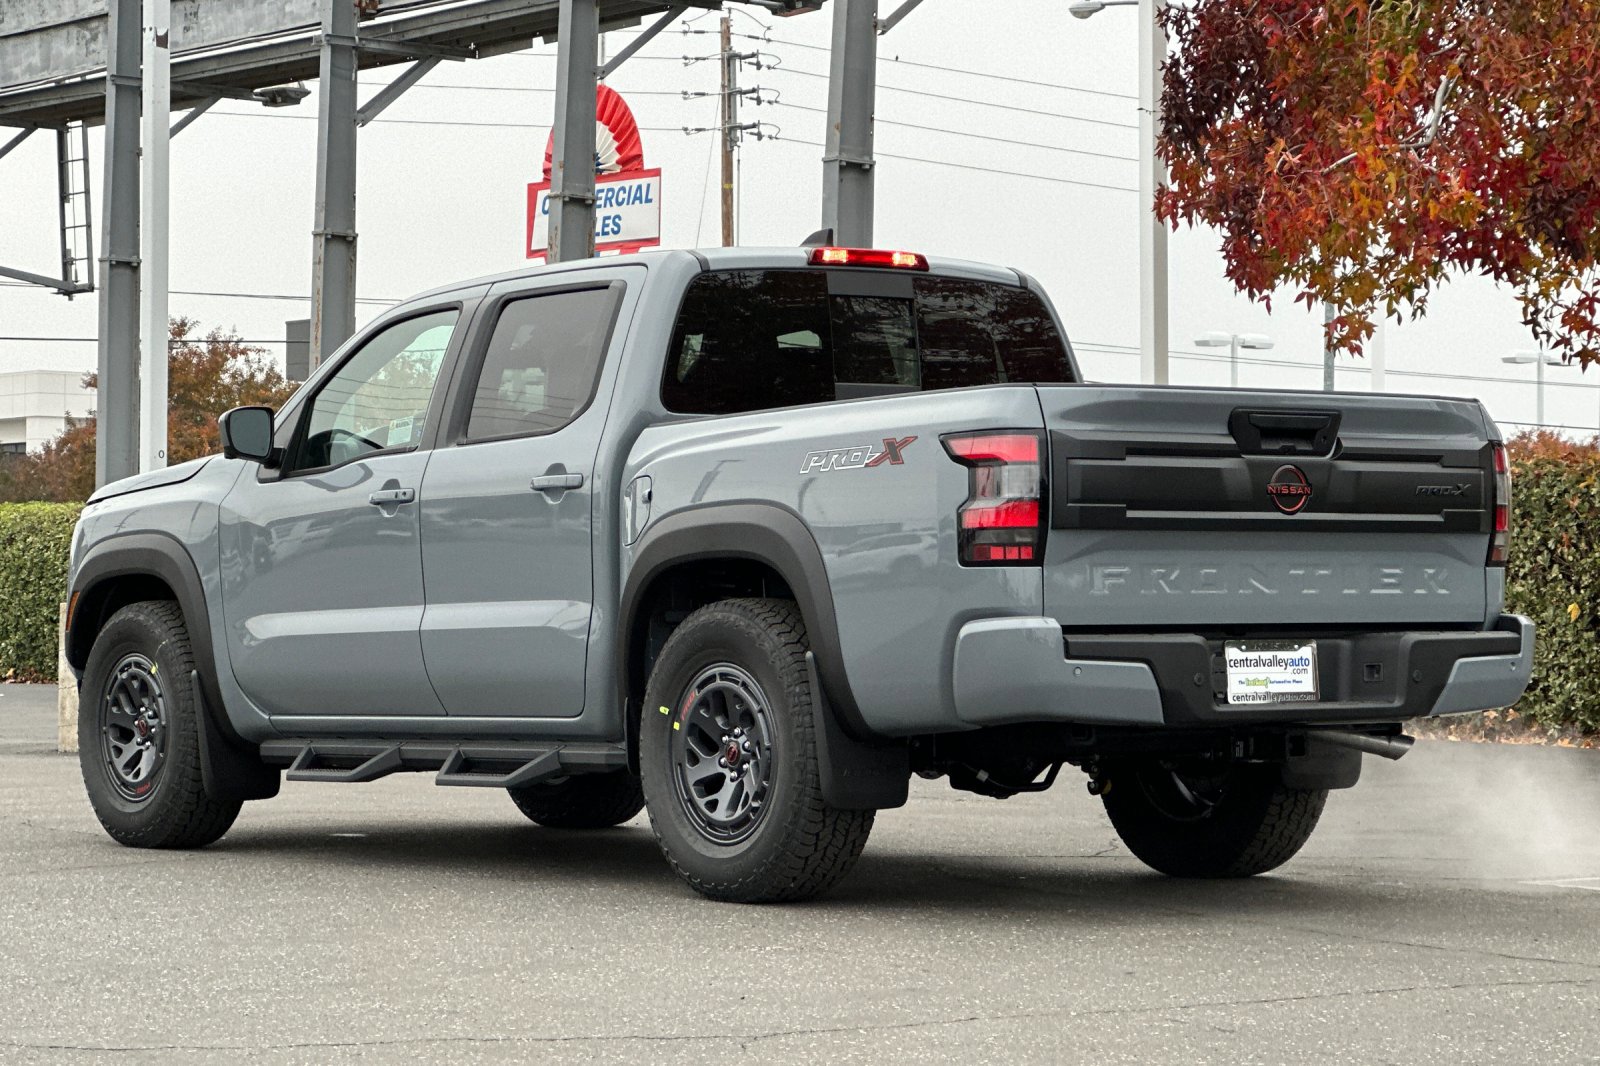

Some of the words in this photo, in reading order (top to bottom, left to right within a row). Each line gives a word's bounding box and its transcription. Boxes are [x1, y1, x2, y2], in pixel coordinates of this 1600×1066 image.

[541, 183, 653, 215] CERCIAL
[1267, 484, 1311, 494] NISSAN
[1087, 563, 1450, 595] FRONTIER
[1229, 655, 1310, 670] centralvalleyauto
